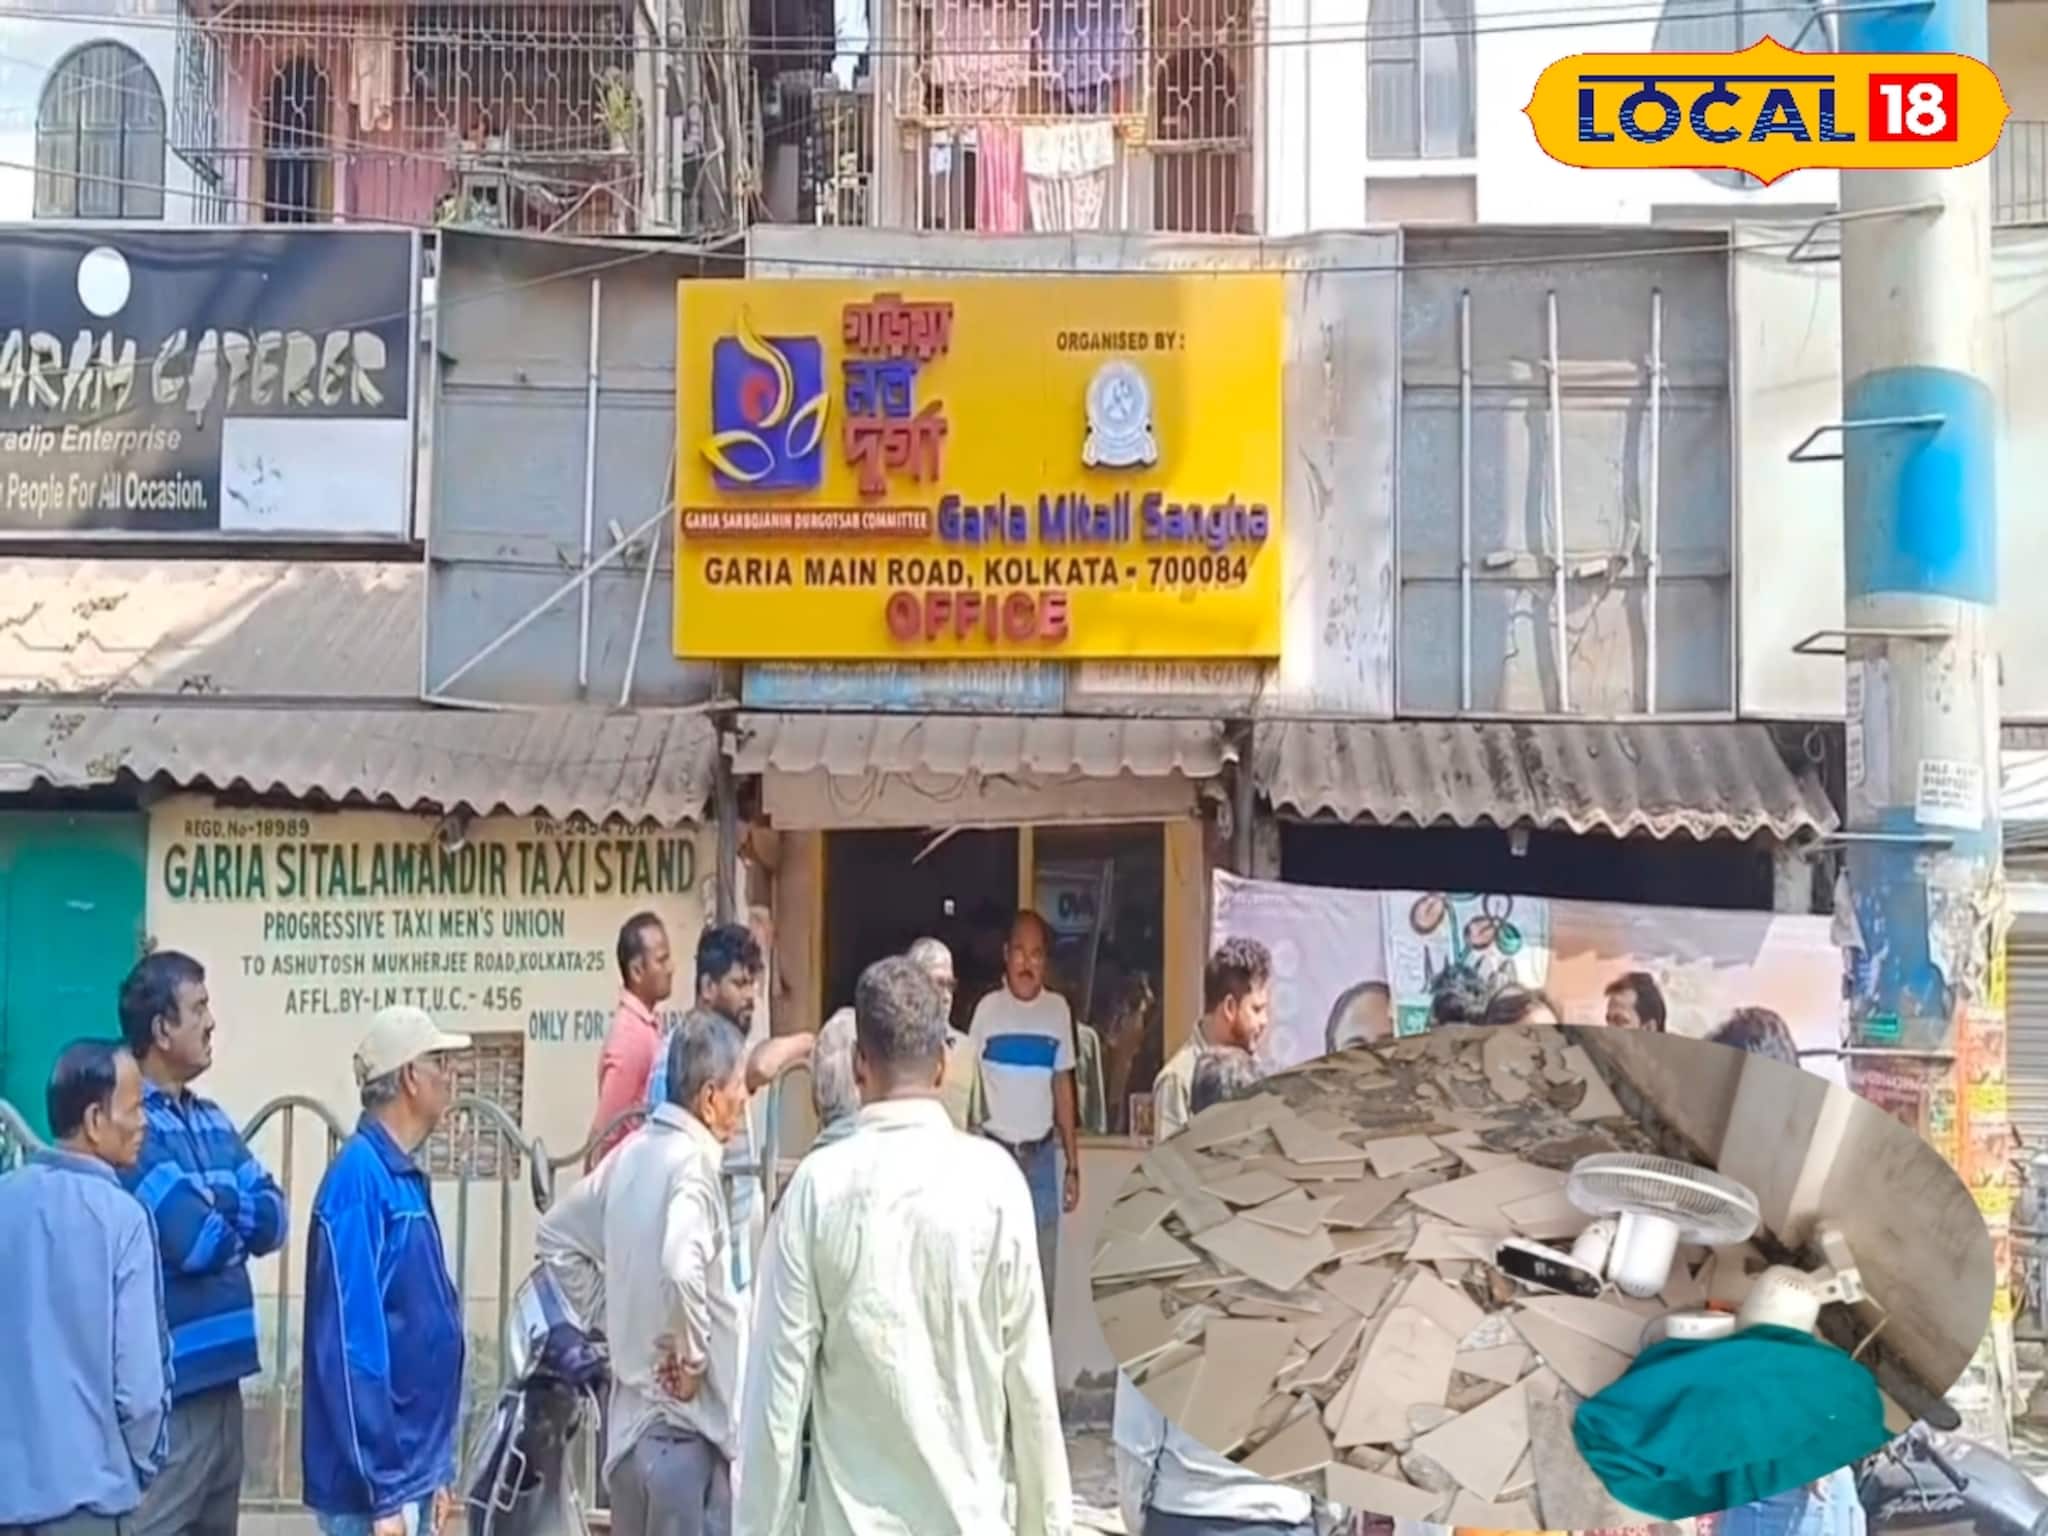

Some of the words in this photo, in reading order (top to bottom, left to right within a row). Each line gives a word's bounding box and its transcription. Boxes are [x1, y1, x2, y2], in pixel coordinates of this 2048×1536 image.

[1056, 331, 1149, 351] ORGANISED
[152, 328, 387, 418] CATERER
[60, 424, 182, 456] Enterprise
[6, 472, 64, 518] People
[67, 472, 96, 508] For
[98, 470, 121, 509] All
[125, 472, 208, 510] Occasion.
[685, 512, 720, 530] GARIA
[862, 512, 928, 530] COMMITTEE
[705, 557, 793, 586] GARIA
[804, 558, 877, 586] MAIN
[887, 558, 974, 590] ROAD,
[984, 557, 1119, 585] KOLKATA
[1147, 555, 1248, 585] 700084
[886, 591, 1069, 643] OFFICE
[164, 844, 265, 898] GARIA
[275, 842, 507, 897] SITALAMANDIR
[516, 841, 585, 894] TAXI
[594, 840, 695, 894] STAND
[264, 911, 385, 941] PROGRESSIVE
[393, 910, 433, 939] TAXI
[439, 907, 495, 938] MEN'S
[502, 909, 565, 938] UNION
[241, 955, 265, 976] TO
[272, 954, 365, 975] ASHUTOSH
[372, 952, 468, 973] MUKHERJEE
[481, 986, 523, 1011] 456
[529, 1010, 567, 1041] ONLY
[573, 1011, 604, 1041] FOR
